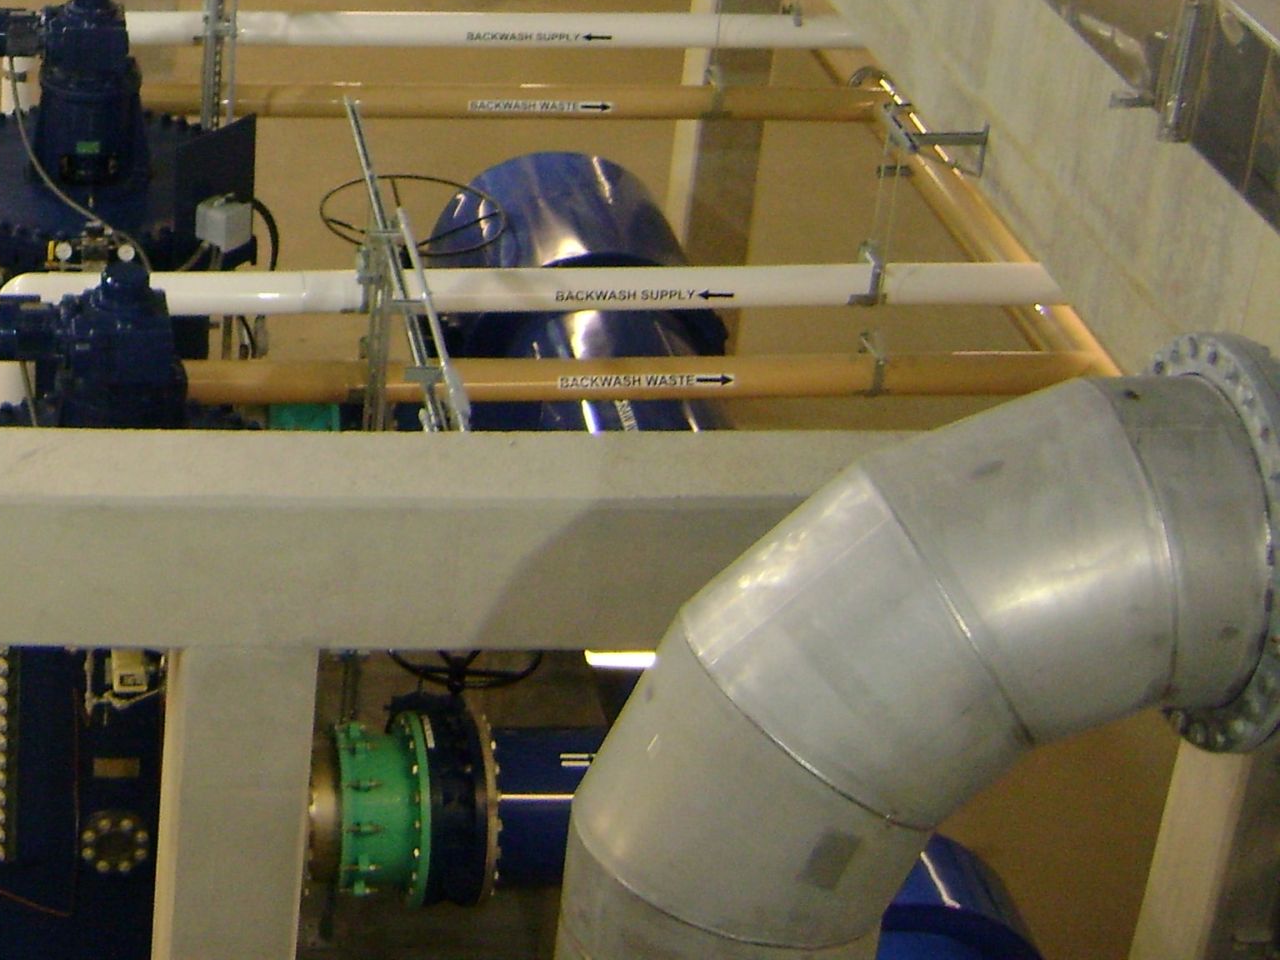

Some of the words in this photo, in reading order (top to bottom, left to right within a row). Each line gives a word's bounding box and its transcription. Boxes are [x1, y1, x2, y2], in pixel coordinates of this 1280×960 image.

[466, 31, 533, 41] BACKWASH
[536, 31, 580, 41] SUPPLY
[469, 101, 536, 112] BACKWASH
[554, 289, 637, 302] BACKWASH
[640, 289, 696, 301] SUPPLY
[559, 375, 641, 389] BACKWASH
[645, 374, 695, 388] WASTE
